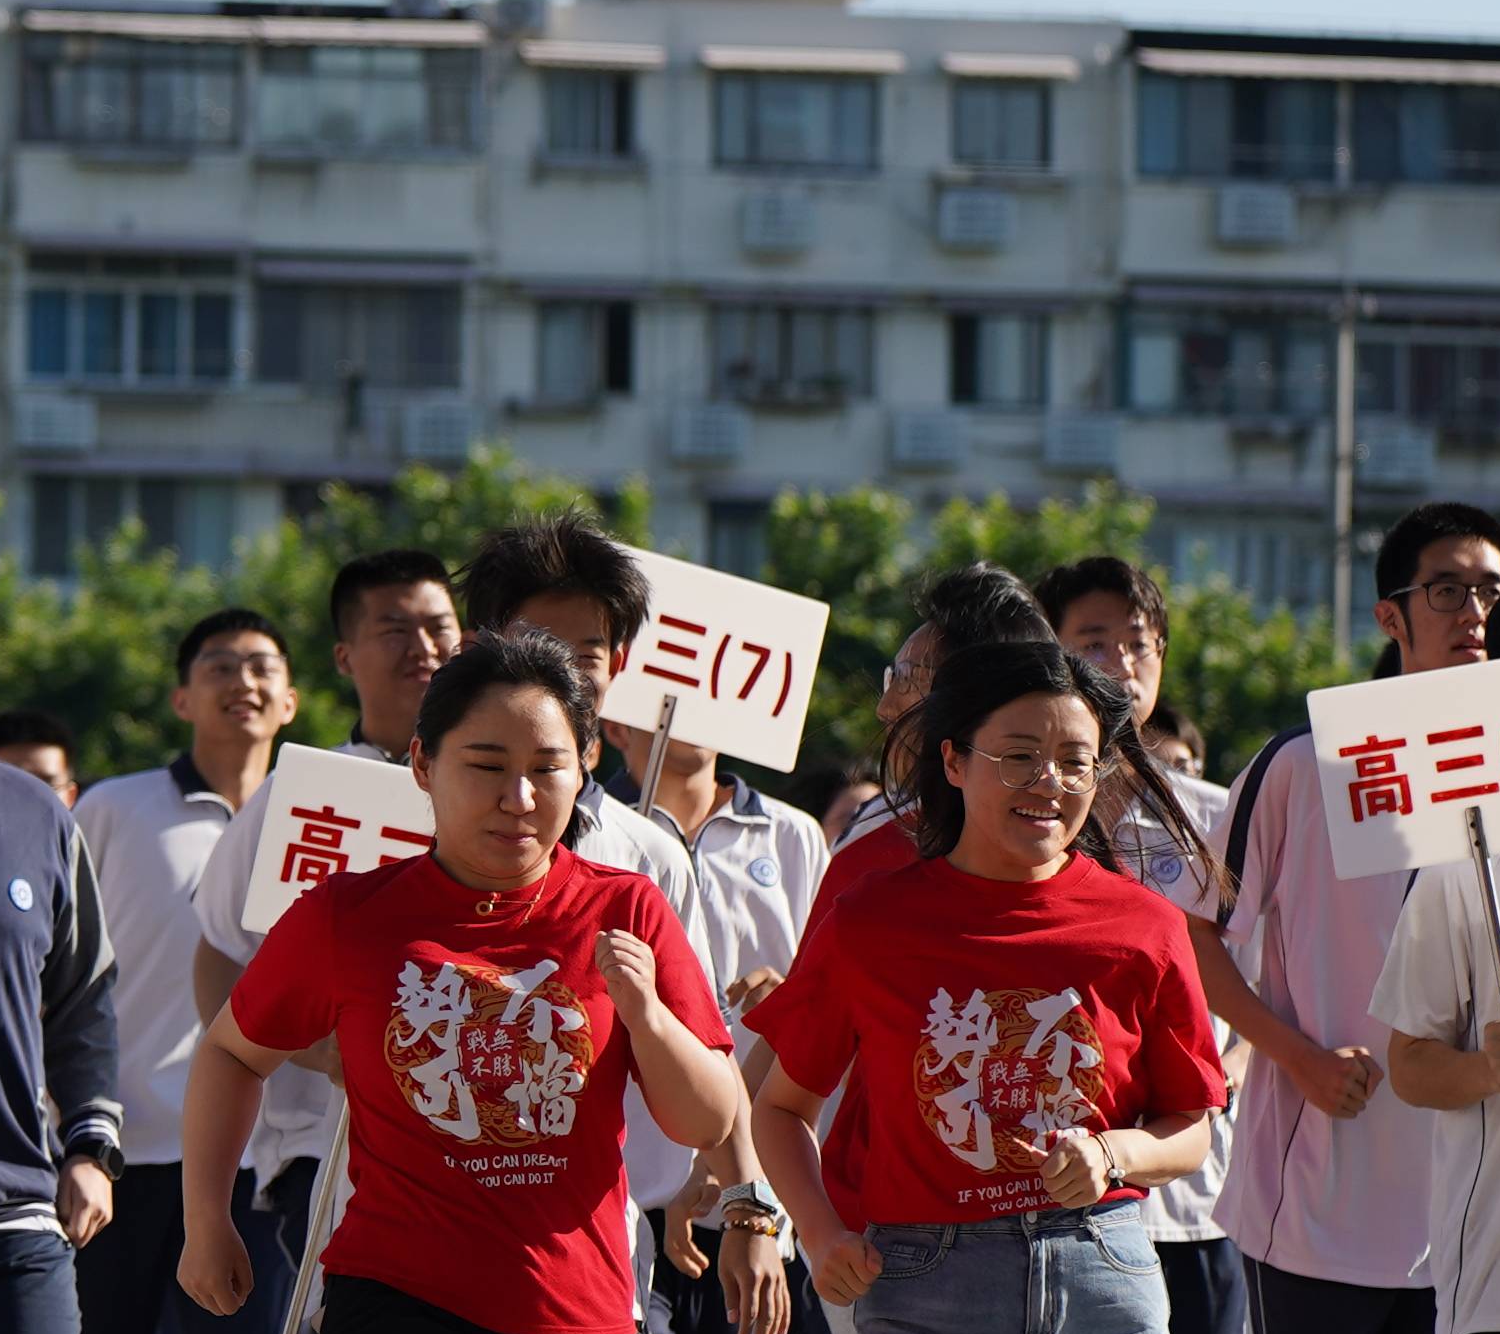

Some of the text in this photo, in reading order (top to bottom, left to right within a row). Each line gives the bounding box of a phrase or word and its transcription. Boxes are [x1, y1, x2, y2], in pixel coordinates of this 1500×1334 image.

[619, 614, 793, 717] 三(7)
[460, 1158, 488, 1172] YOU
[493, 1154, 519, 1168] CAN
[477, 1172, 555, 1187] YOU CAN DO IT
[958, 1190, 972, 1203] IF
[977, 1186, 1002, 1200] YOU
[1006, 1179, 1031, 1194] CAN
[990, 1201, 1012, 1212] YOU
[1016, 1195, 1038, 1208] CAN
